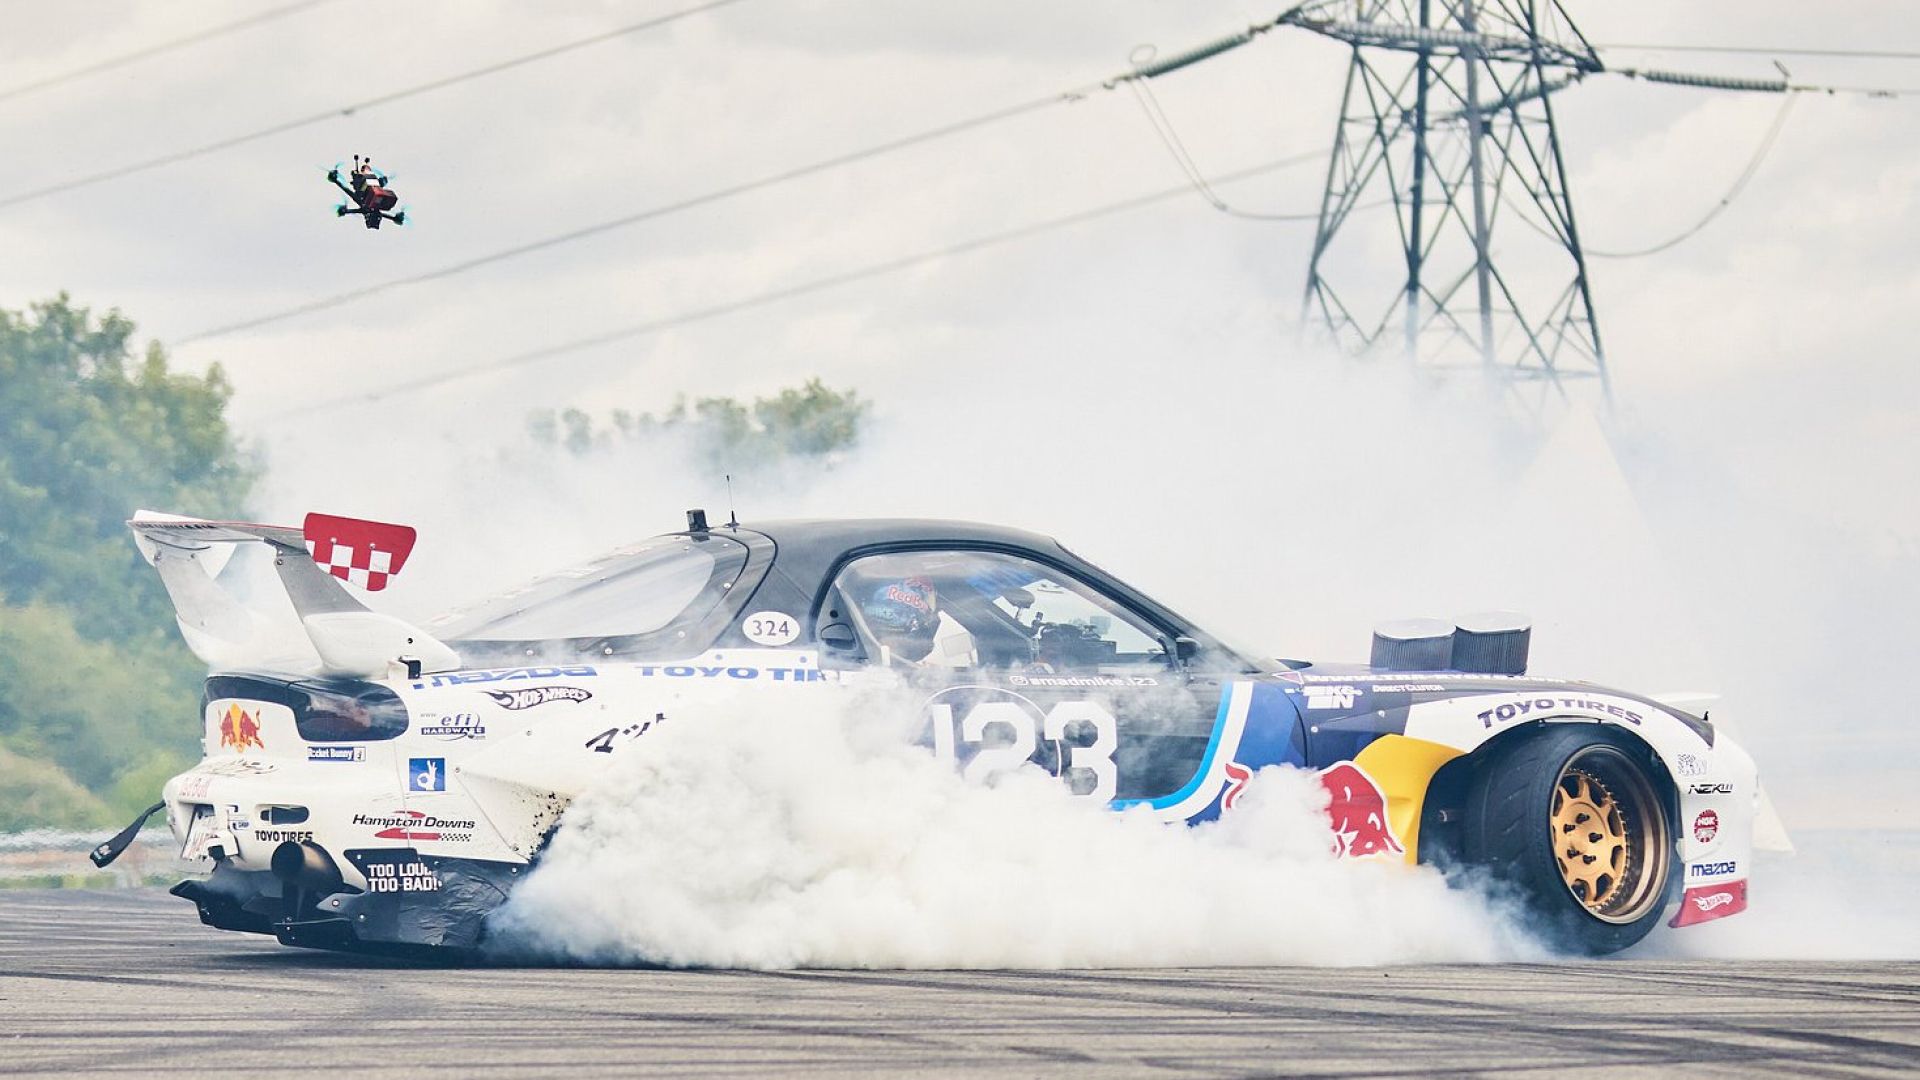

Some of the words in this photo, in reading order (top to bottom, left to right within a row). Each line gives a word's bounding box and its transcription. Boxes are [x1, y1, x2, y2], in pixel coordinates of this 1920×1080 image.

[752, 619, 789, 637] 324
[635, 666, 759, 680] TOYO
[441, 713, 472, 727] efi
[1477, 698, 1555, 729] TOYO
[1558, 698, 1643, 727] TIRES
[931, 701, 1117, 805] 123
[353, 813, 421, 828] Hampton
[424, 816, 476, 829] Downs
[255, 830, 280, 842] TOYO
[282, 831, 312, 843] TIRES
[367, 863, 396, 877] TOO
[369, 878, 399, 892] TOO
[403, 876, 438, 891] BAD!
